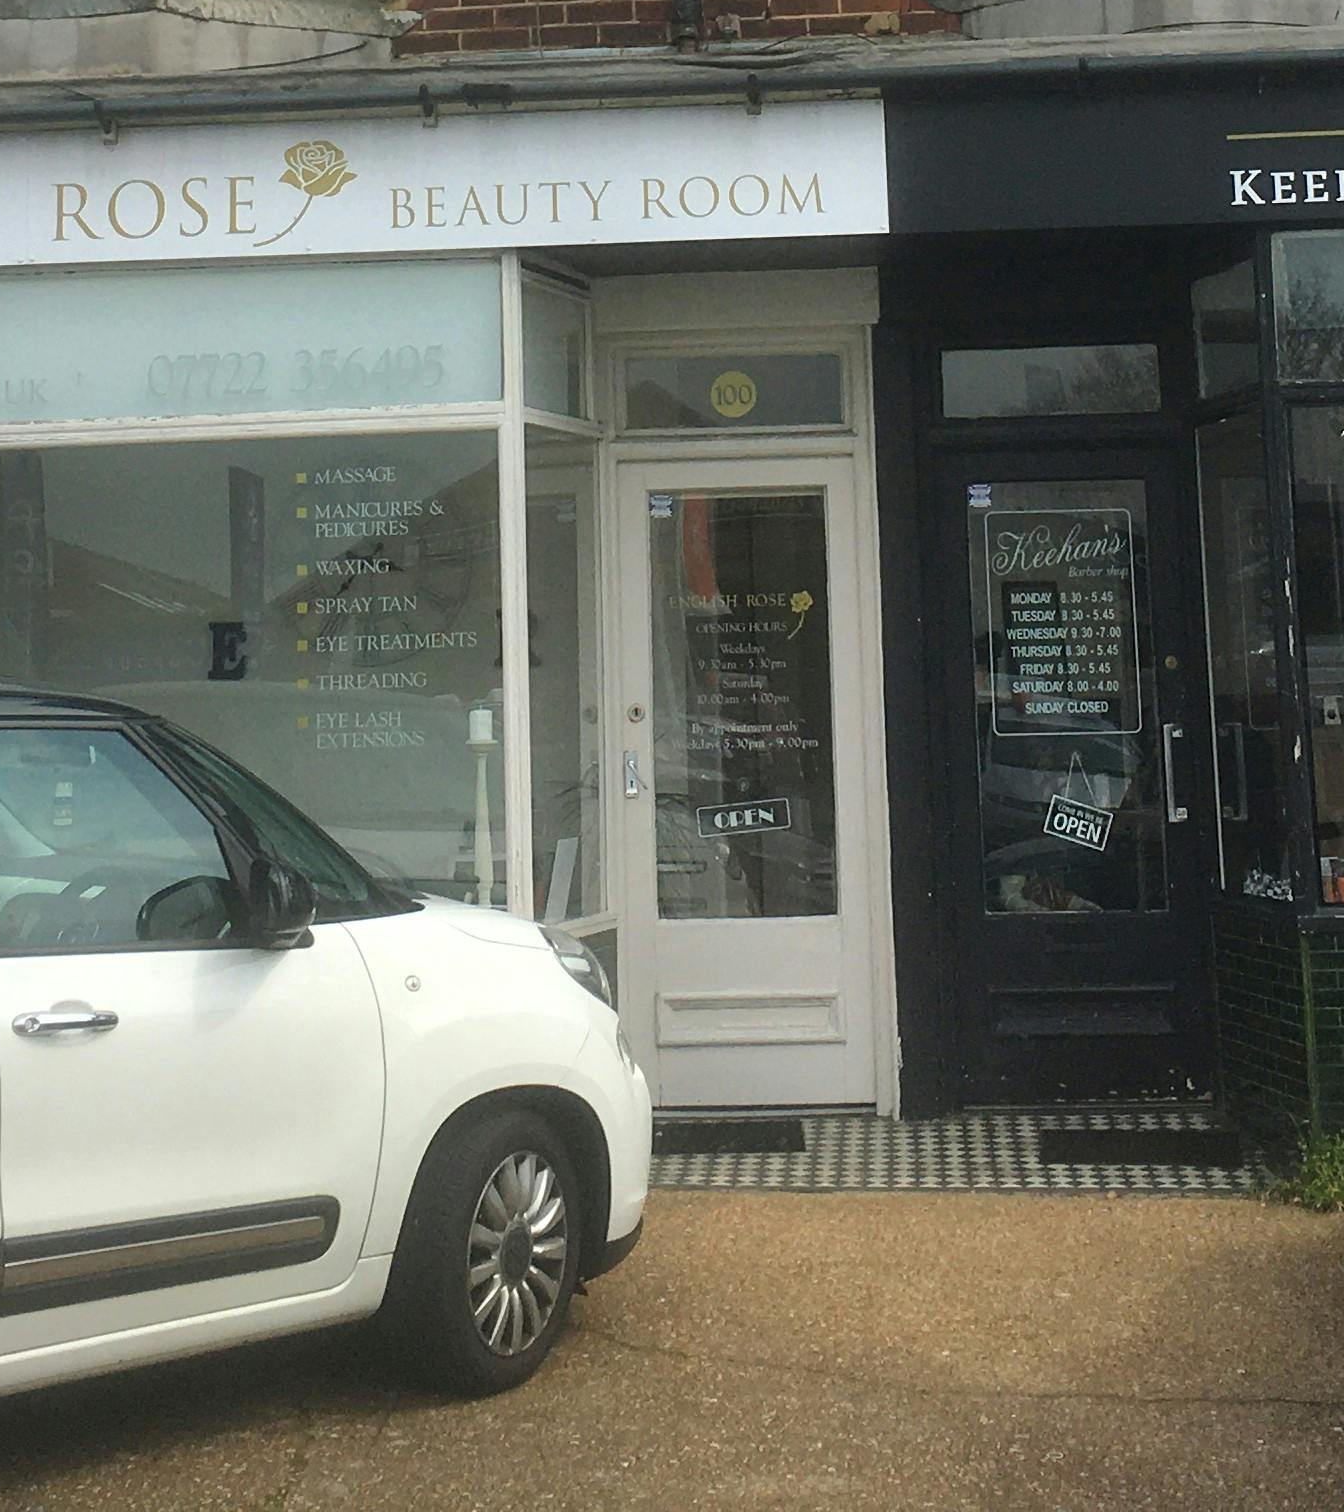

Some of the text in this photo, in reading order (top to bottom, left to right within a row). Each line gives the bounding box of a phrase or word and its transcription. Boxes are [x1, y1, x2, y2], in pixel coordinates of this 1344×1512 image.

[51, 174, 257, 242] ROSE
[389, 172, 827, 230] BEAUTY ROOM
[715, 383, 753, 407] 100
[314, 465, 397, 486] MASSAGE
[314, 500, 445, 520] MANICURES &
[314, 521, 409, 539] PEDICURES
[991, 522, 1127, 576] Keehan's
[315, 558, 390, 576] WAXING
[314, 595, 417, 616] SPRAY TAN
[668, 592, 787, 609] ENGLISH ROSE
[1010, 592, 1052, 605] MONDAY
[1010, 610, 1057, 622] TUESDAY
[695, 620, 788, 634] OPENING HOURS
[1006, 627, 1069, 640] WEDNESDAY
[315, 631, 478, 654] EYE TREATMENTS
[720, 642, 766, 656] Weekdays
[1010, 645, 1062, 658] THURSDAY
[1019, 663, 1054, 676] FRIDAY
[316, 671, 427, 691] THREADING
[722, 676, 763, 691] Saturday
[1012, 681, 1064, 694] SATURDAY
[1024, 700, 1109, 715] SUNDAY CLOSED
[315, 711, 402, 731] EYE LASH
[691, 720, 799, 736] By appointment only
[315, 731, 425, 750] EXTENSIONS
[723, 737, 766, 751] 5.30pm
[714, 808, 775, 829] OPEN
[1053, 812, 1103, 843] OPEN
